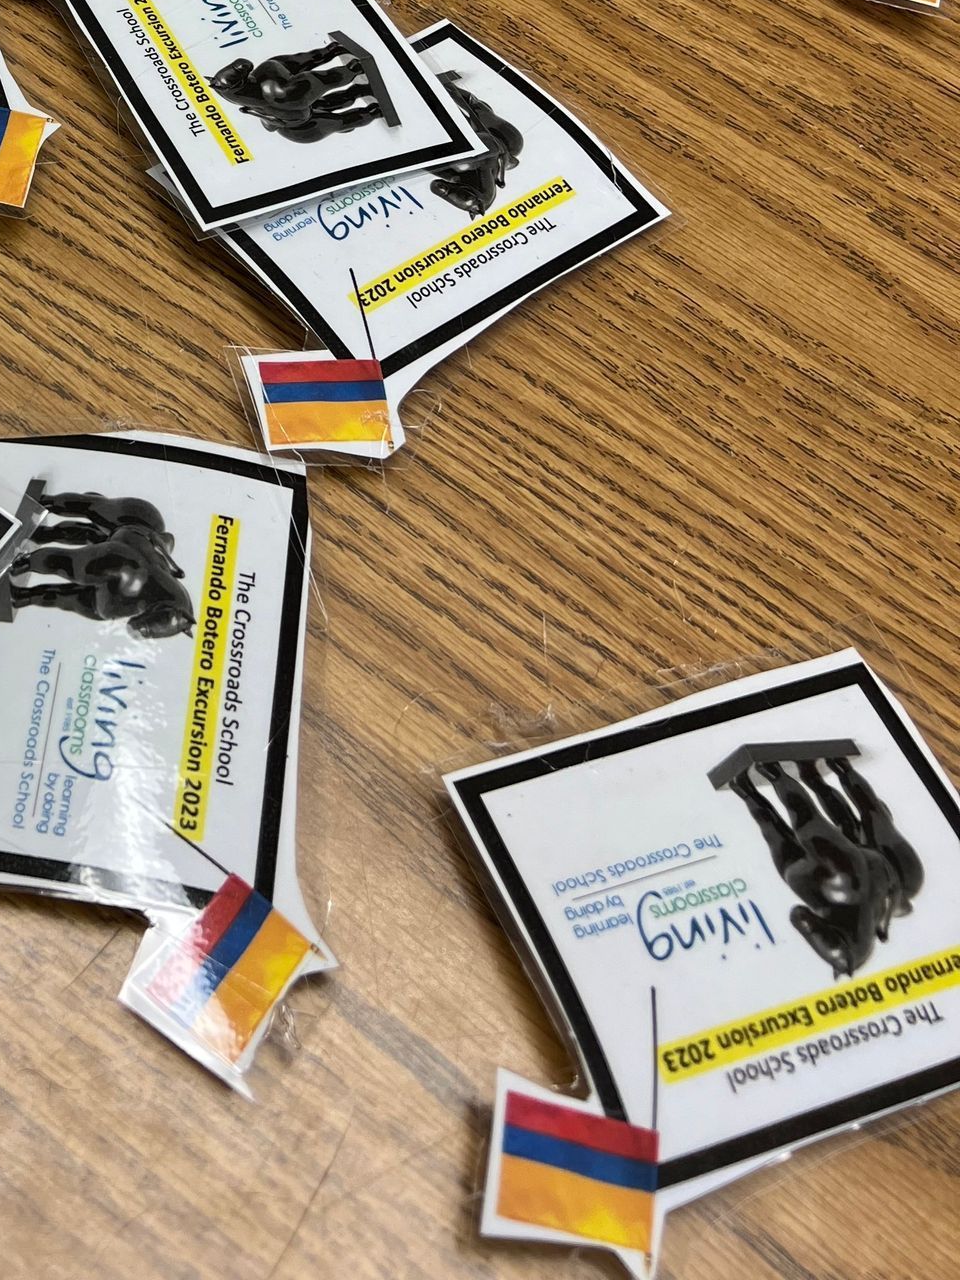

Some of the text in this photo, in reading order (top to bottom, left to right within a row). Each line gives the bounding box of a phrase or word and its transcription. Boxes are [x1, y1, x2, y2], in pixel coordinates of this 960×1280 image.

[115, 7, 206, 138] The Crossroads School
[142, 7, 183, 60] Excursion
[178, 62, 210, 102] Botero
[205, 103, 250, 165] Fernando
[316, 184, 426, 244] living
[355, 178, 573, 308] Fernando Botero Excursion 2023
[405, 216, 557, 310] The Crossroads School
[57, 657, 147, 782] living
[68, 654, 99, 755] classrooms
[179, 514, 234, 833] Fernando Botero Excursion 2023
[215, 570, 256, 787] The Crossroads School
[553, 834, 724, 897] The Crossroads School
[648, 878, 747, 919] classrooms
[634, 891, 777, 965] living
[660, 953, 960, 1072] ernando Botero Excursion 2023
[725, 1002, 946, 1094] The Crossroads School
